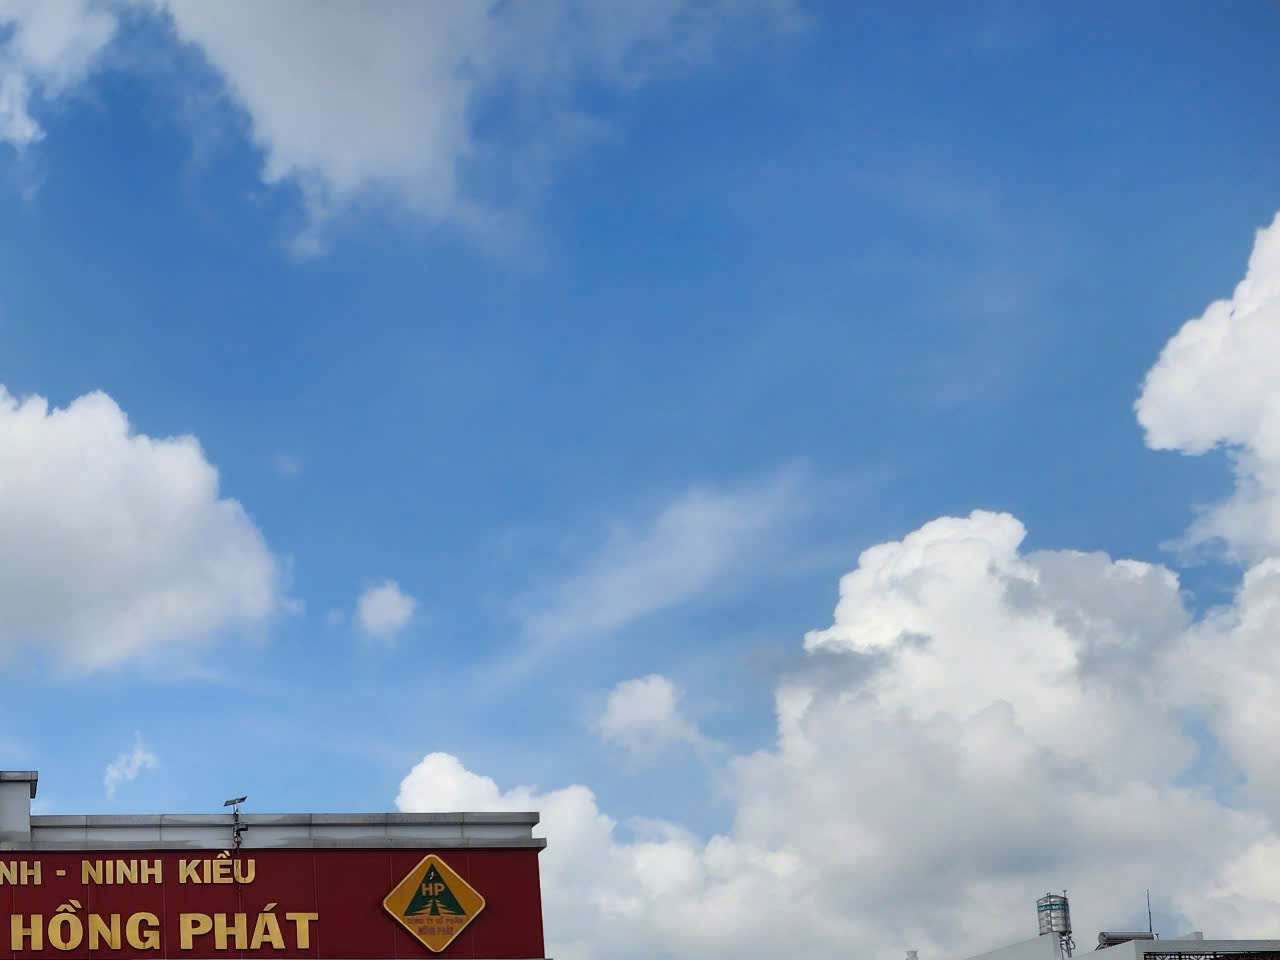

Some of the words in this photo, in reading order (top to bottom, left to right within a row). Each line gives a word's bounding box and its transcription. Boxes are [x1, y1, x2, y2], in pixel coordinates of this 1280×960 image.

[56, 869, 66, 877] -
[81, 859, 163, 885] NINH
[178, 850, 256, 884] KIỀU
[421, 882, 446, 897] HP
[10, 899, 161, 951] HỒNG
[179, 902, 319, 950] PHÁT
